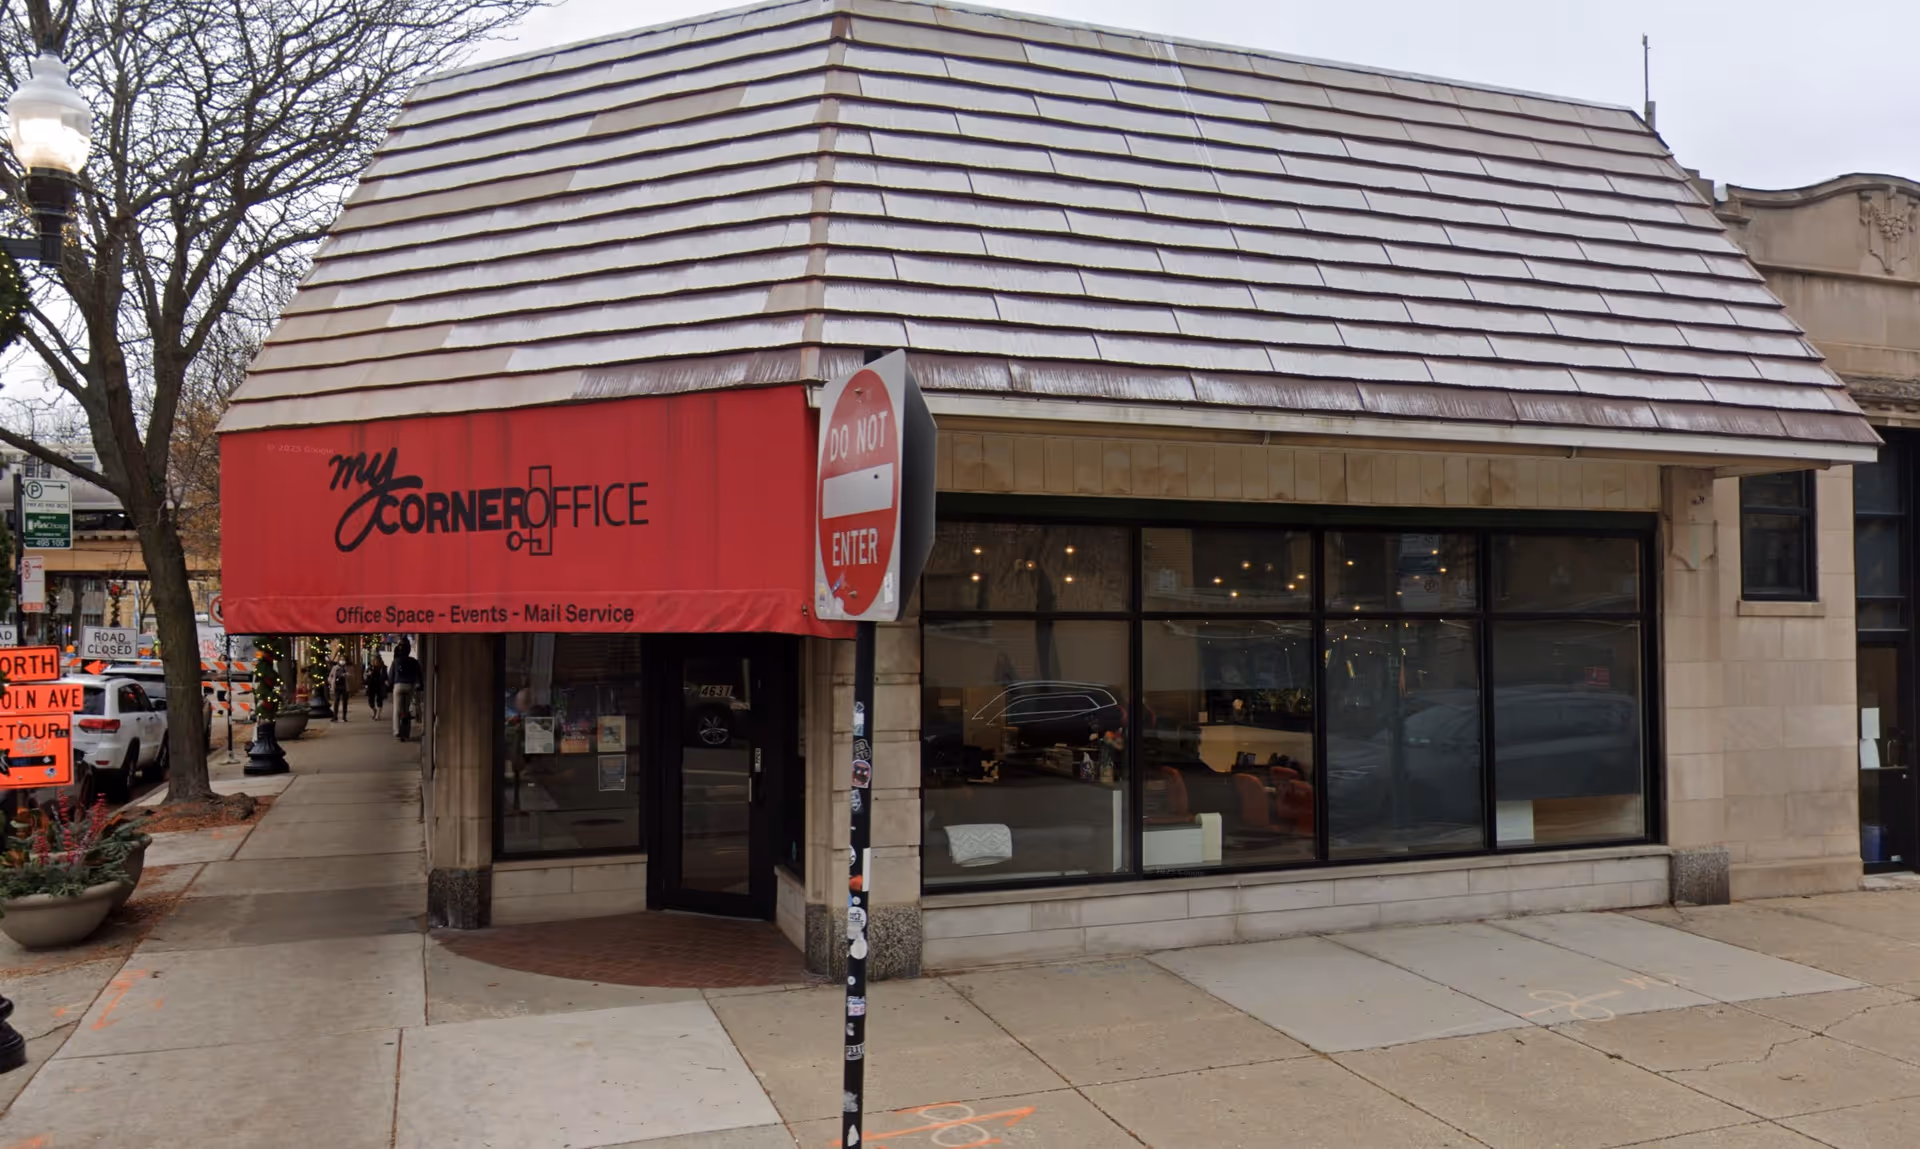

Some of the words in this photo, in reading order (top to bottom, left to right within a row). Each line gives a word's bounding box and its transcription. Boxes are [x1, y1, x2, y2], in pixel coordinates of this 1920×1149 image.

[830, 424, 849, 462] DO
[856, 411, 888, 453] NOT
[328, 447, 423, 553] my
[832, 528, 878, 567] ENTER
[336, 606, 381, 624] Office
[386, 606, 434, 627] Space
[451, 604, 508, 623] Events
[525, 603, 561, 622] Mail
[565, 603, 635, 623] Service
[94, 632, 126, 642] ROAD
[88, 645, 132, 655] CLOSED
[48, 689, 81, 709] AVE
[702, 685, 730, 697] 4631
